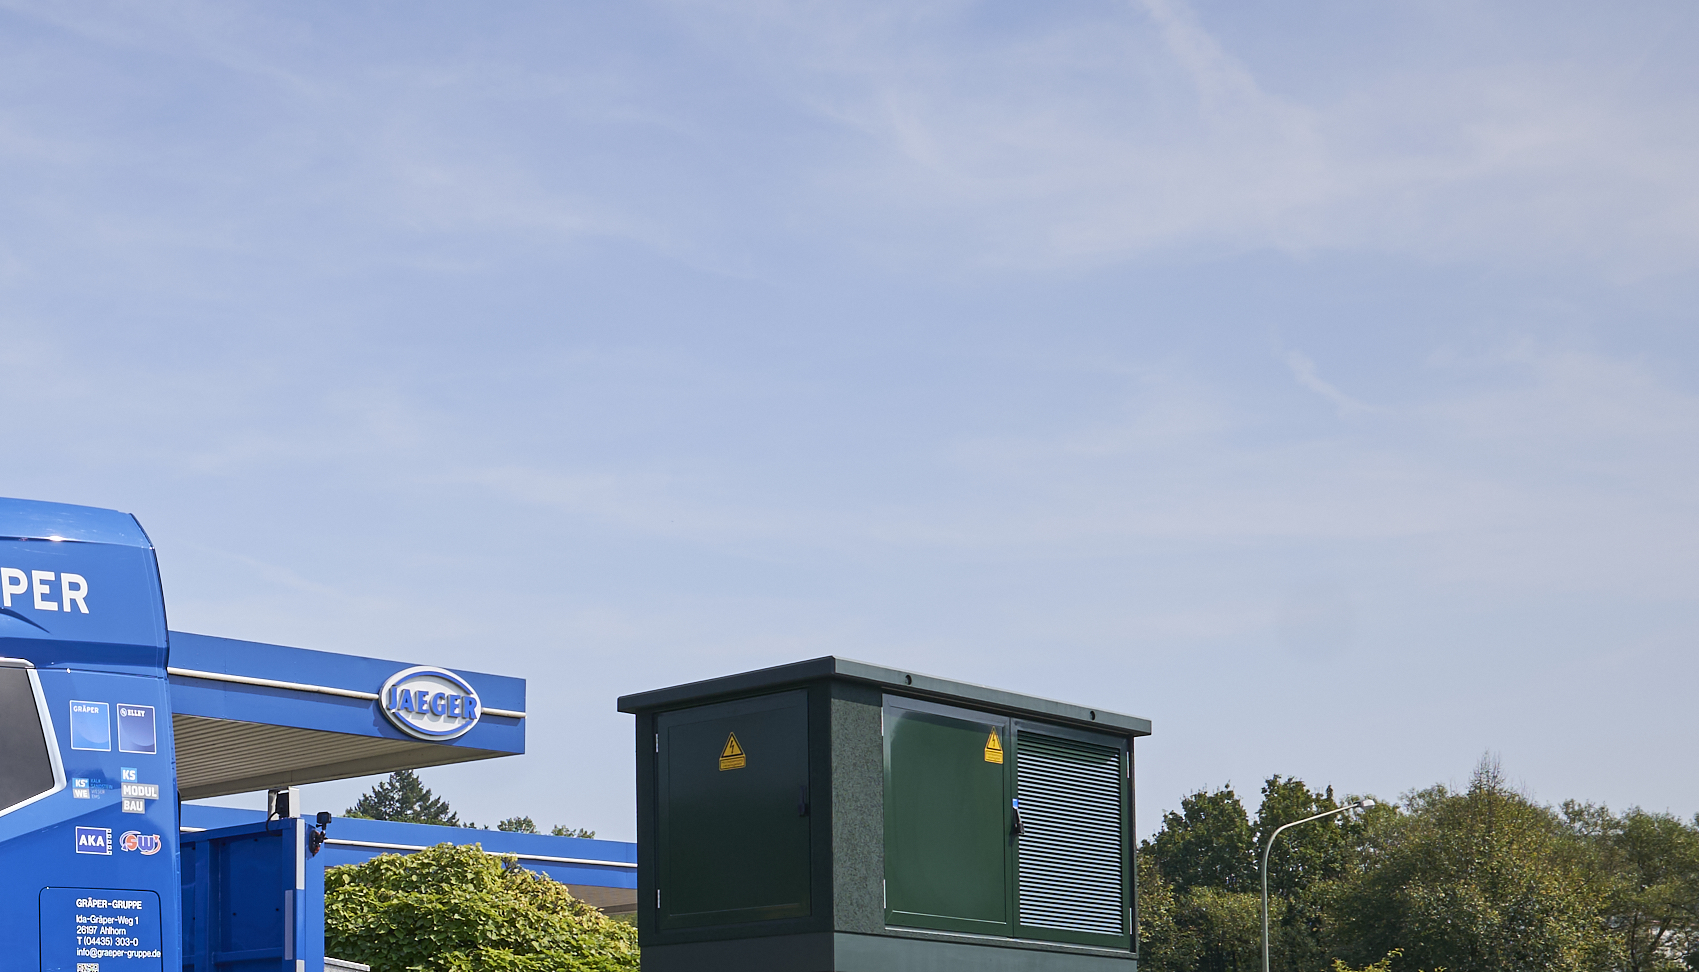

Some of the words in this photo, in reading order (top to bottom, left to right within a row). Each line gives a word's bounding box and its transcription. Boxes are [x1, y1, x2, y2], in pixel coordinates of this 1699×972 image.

[73, 704, 99, 714] GRÄPER
[386, 686, 477, 720] JAEGER
[122, 769, 136, 781] KS
[74, 789, 88, 798] WE
[123, 785, 158, 798] MODUL
[123, 800, 143, 812] BAU
[79, 834, 105, 847] AKA
[76, 897, 142, 909] GRÄPER-GRUPPE
[76, 914, 133, 926] Ida-Gräper-Weg
[134, 916, 139, 925] 1
[76, 925, 98, 935] 26197
[100, 926, 127, 935] Ahlhorn
[76, 936, 83, 945] T
[83, 936, 113, 946] (04435)
[115, 937, 139, 947] 303-0
[76, 947, 161, 959] info@graeper-gruppe.de
